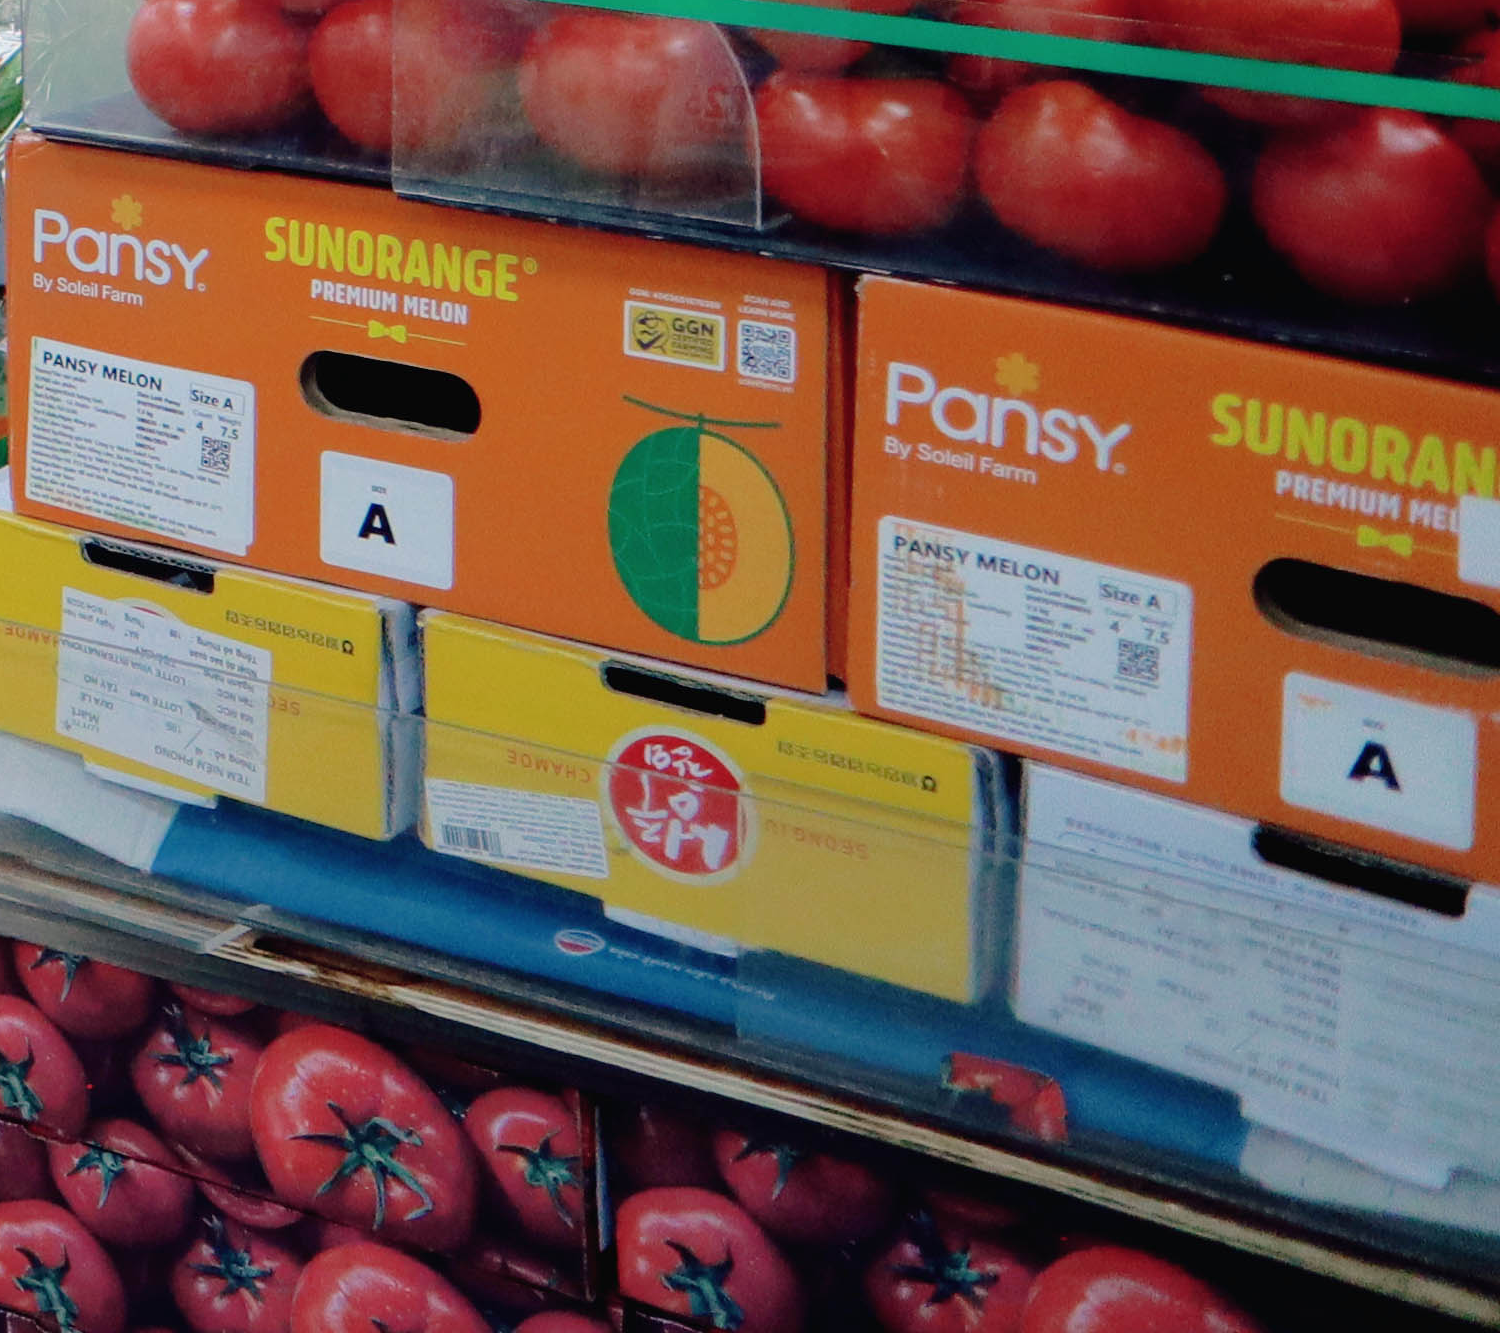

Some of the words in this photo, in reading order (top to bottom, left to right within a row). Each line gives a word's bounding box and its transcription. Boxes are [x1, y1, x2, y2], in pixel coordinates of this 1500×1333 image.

[33, 208, 210, 290] Pansy
[264, 217, 519, 301] SUNORANGE
[32, 272, 53, 290] By
[56, 278, 99, 299] Soleil
[102, 288, 143, 306] Farm
[311, 278, 397, 312] PREMIUM
[404, 295, 468, 325] MELON
[672, 318, 714, 335] GGN
[43, 351, 97, 375] PANSY
[102, 366, 162, 391] MELON
[190, 389, 219, 407] Size
[223, 397, 233, 410] A
[883, 361, 1131, 474] Pansy
[1209, 392, 1500, 498] SUNORAN
[359, 504, 395, 545] A
[507, 748, 591, 783] CHAMOE
